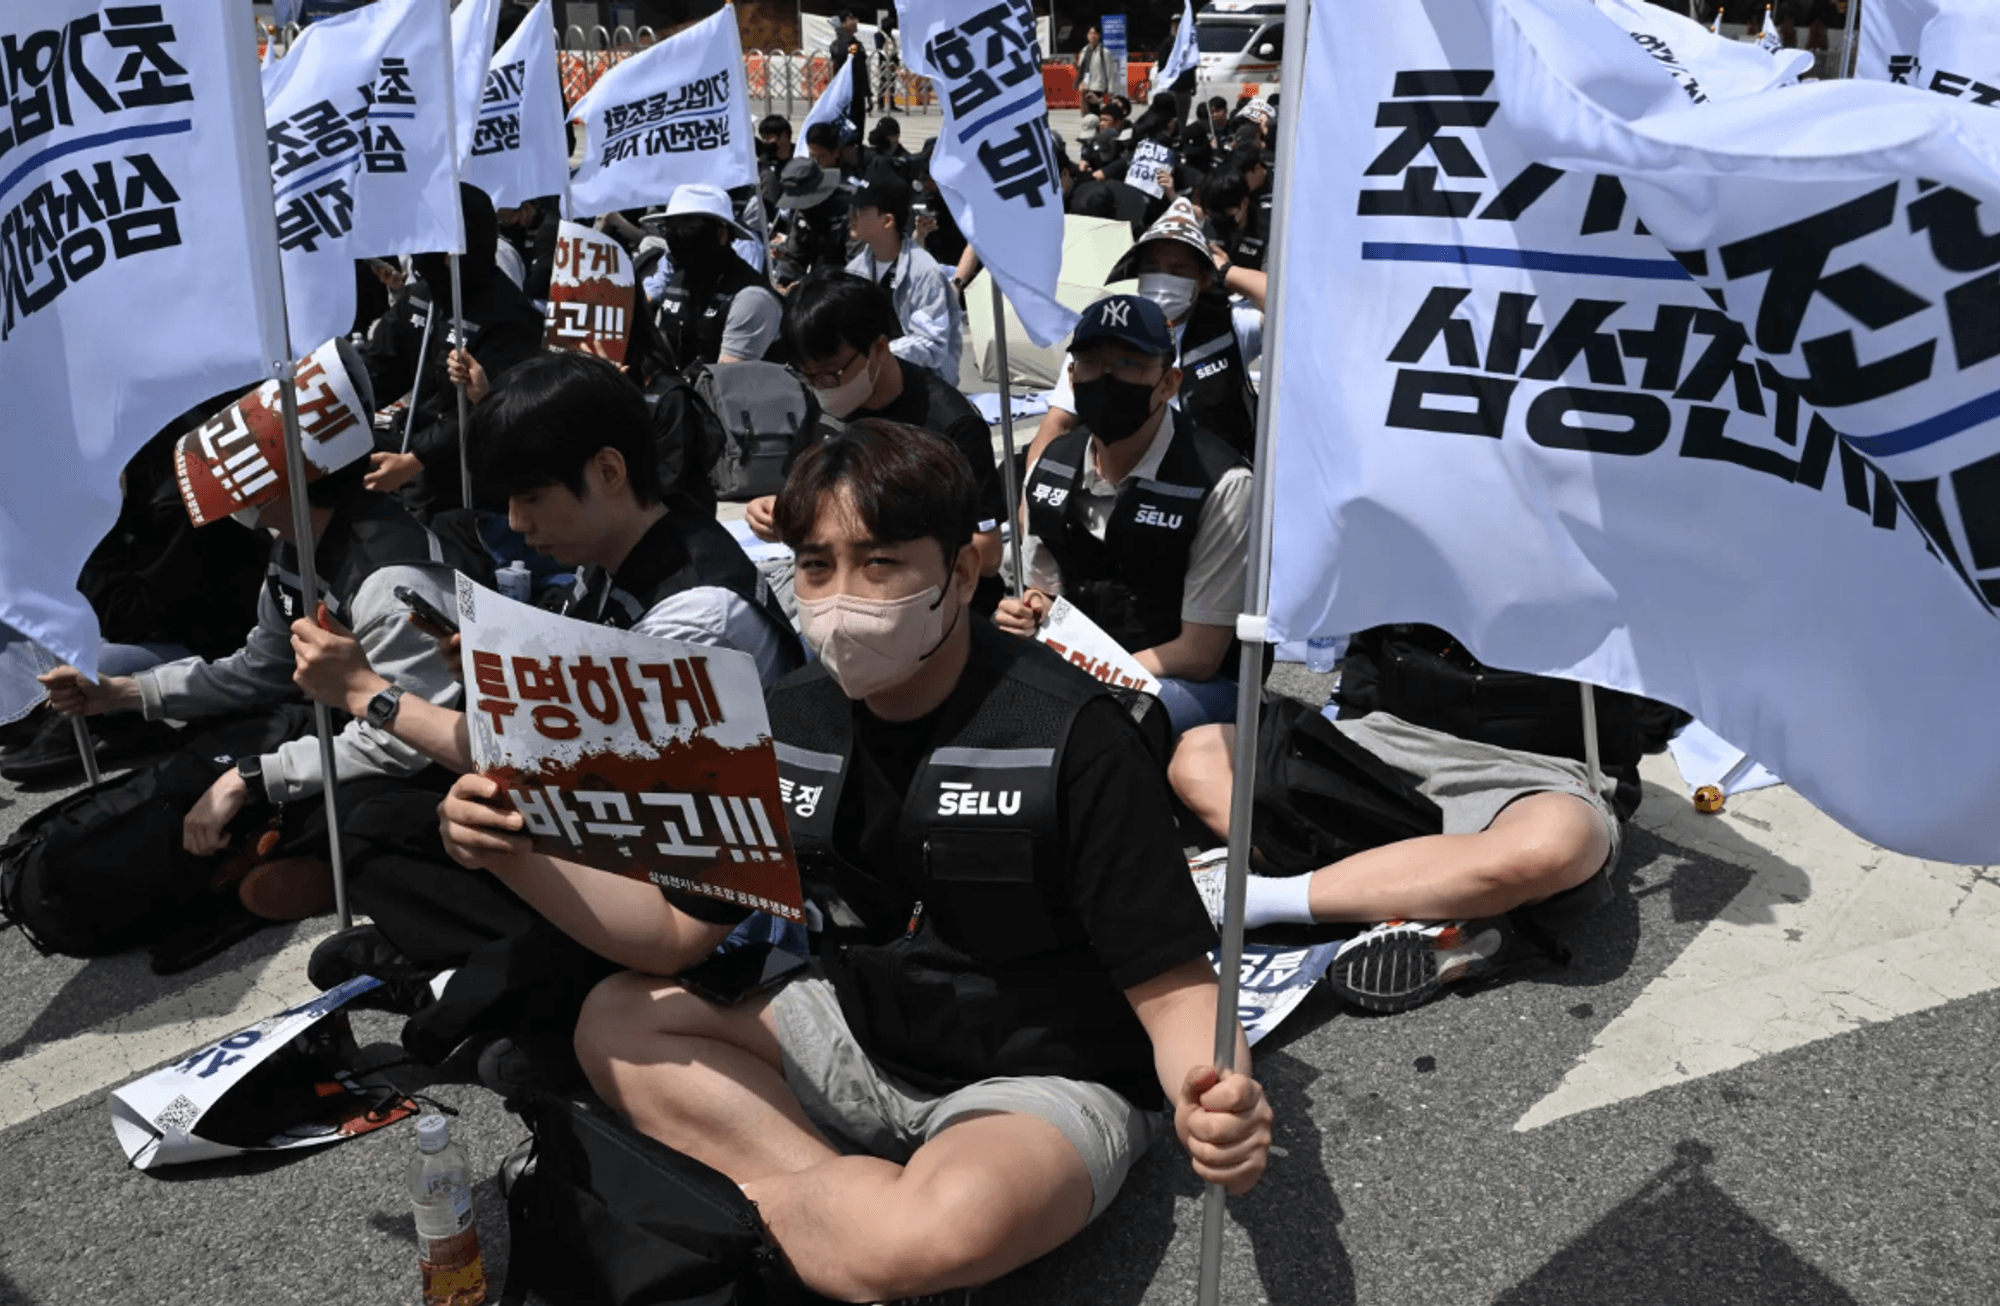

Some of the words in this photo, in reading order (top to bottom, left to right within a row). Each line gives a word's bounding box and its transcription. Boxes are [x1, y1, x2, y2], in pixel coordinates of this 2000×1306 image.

[1196, 358, 1228, 380] SELU
[1032, 483, 1069, 507] 투쟁
[1134, 509, 1183, 530] SELU
[472, 650, 724, 742] 투명하게
[937, 790, 1022, 816] SELU
